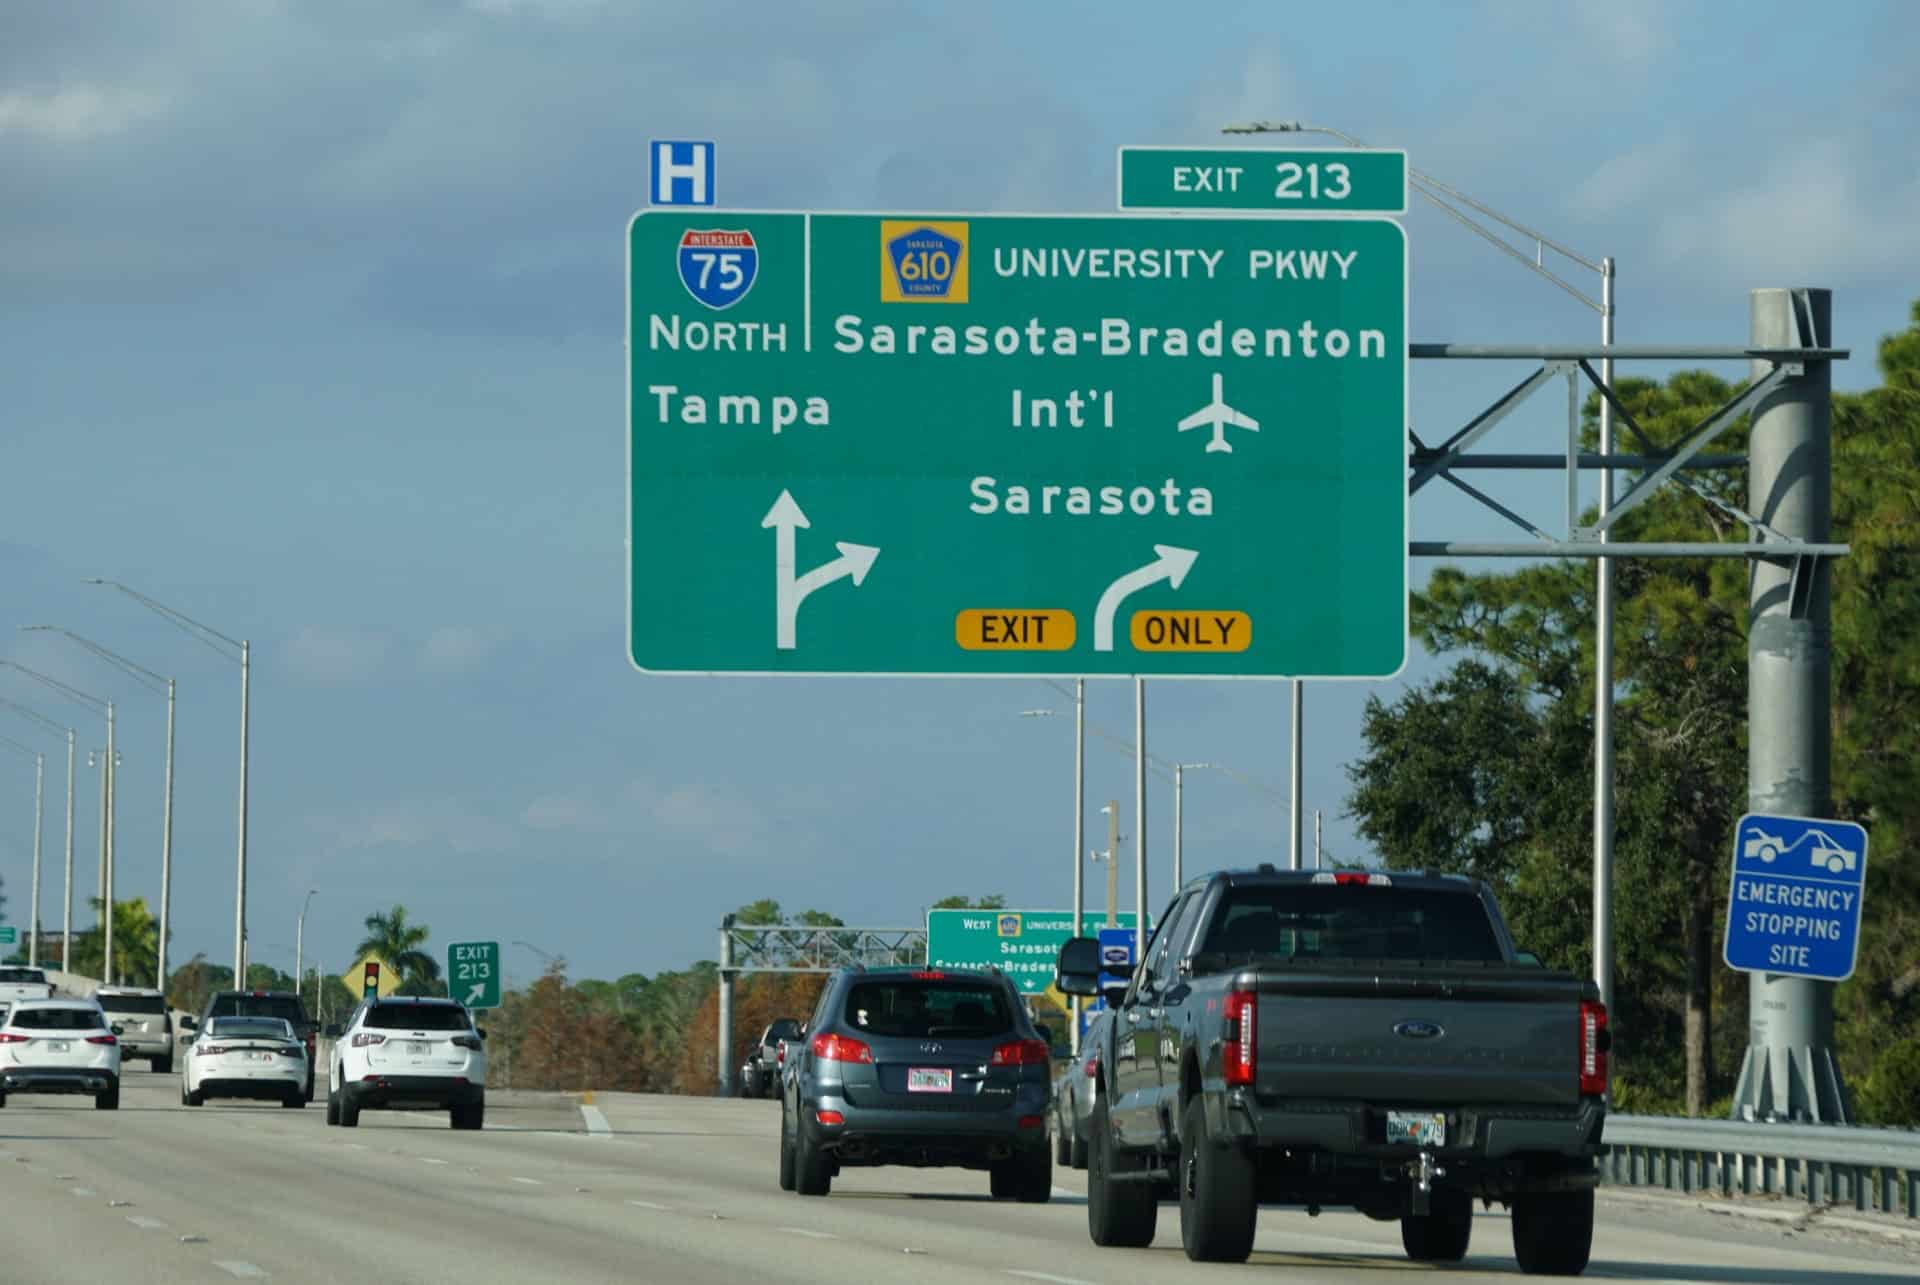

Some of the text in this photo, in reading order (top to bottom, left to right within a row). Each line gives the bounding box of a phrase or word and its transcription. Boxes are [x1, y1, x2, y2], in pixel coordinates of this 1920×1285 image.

[659, 144, 706, 202] H
[1174, 163, 1352, 199] EXIT 213
[690, 234, 744, 247] INTERSTATE
[692, 254, 744, 290] 75
[900, 251, 951, 281] 610
[994, 248, 1358, 279] UNIVERSITY PKWY
[650, 314, 786, 351] NORTH
[834, 315, 1385, 358] Sarasota-Bradenton
[649, 385, 829, 434] Tampa
[1012, 389, 1113, 427] Int'l
[970, 476, 1213, 516] Sarasota
[981, 615, 1236, 645] EXIT ONLY
[1738, 881, 1854, 911] EMERGENCY
[1745, 912, 1841, 940] STOPPING
[456, 946, 490, 960] EXIT
[1000, 942, 1058, 953] Sarasot
[1769, 944, 1810, 967] SITE
[458, 962, 490, 980] 213
